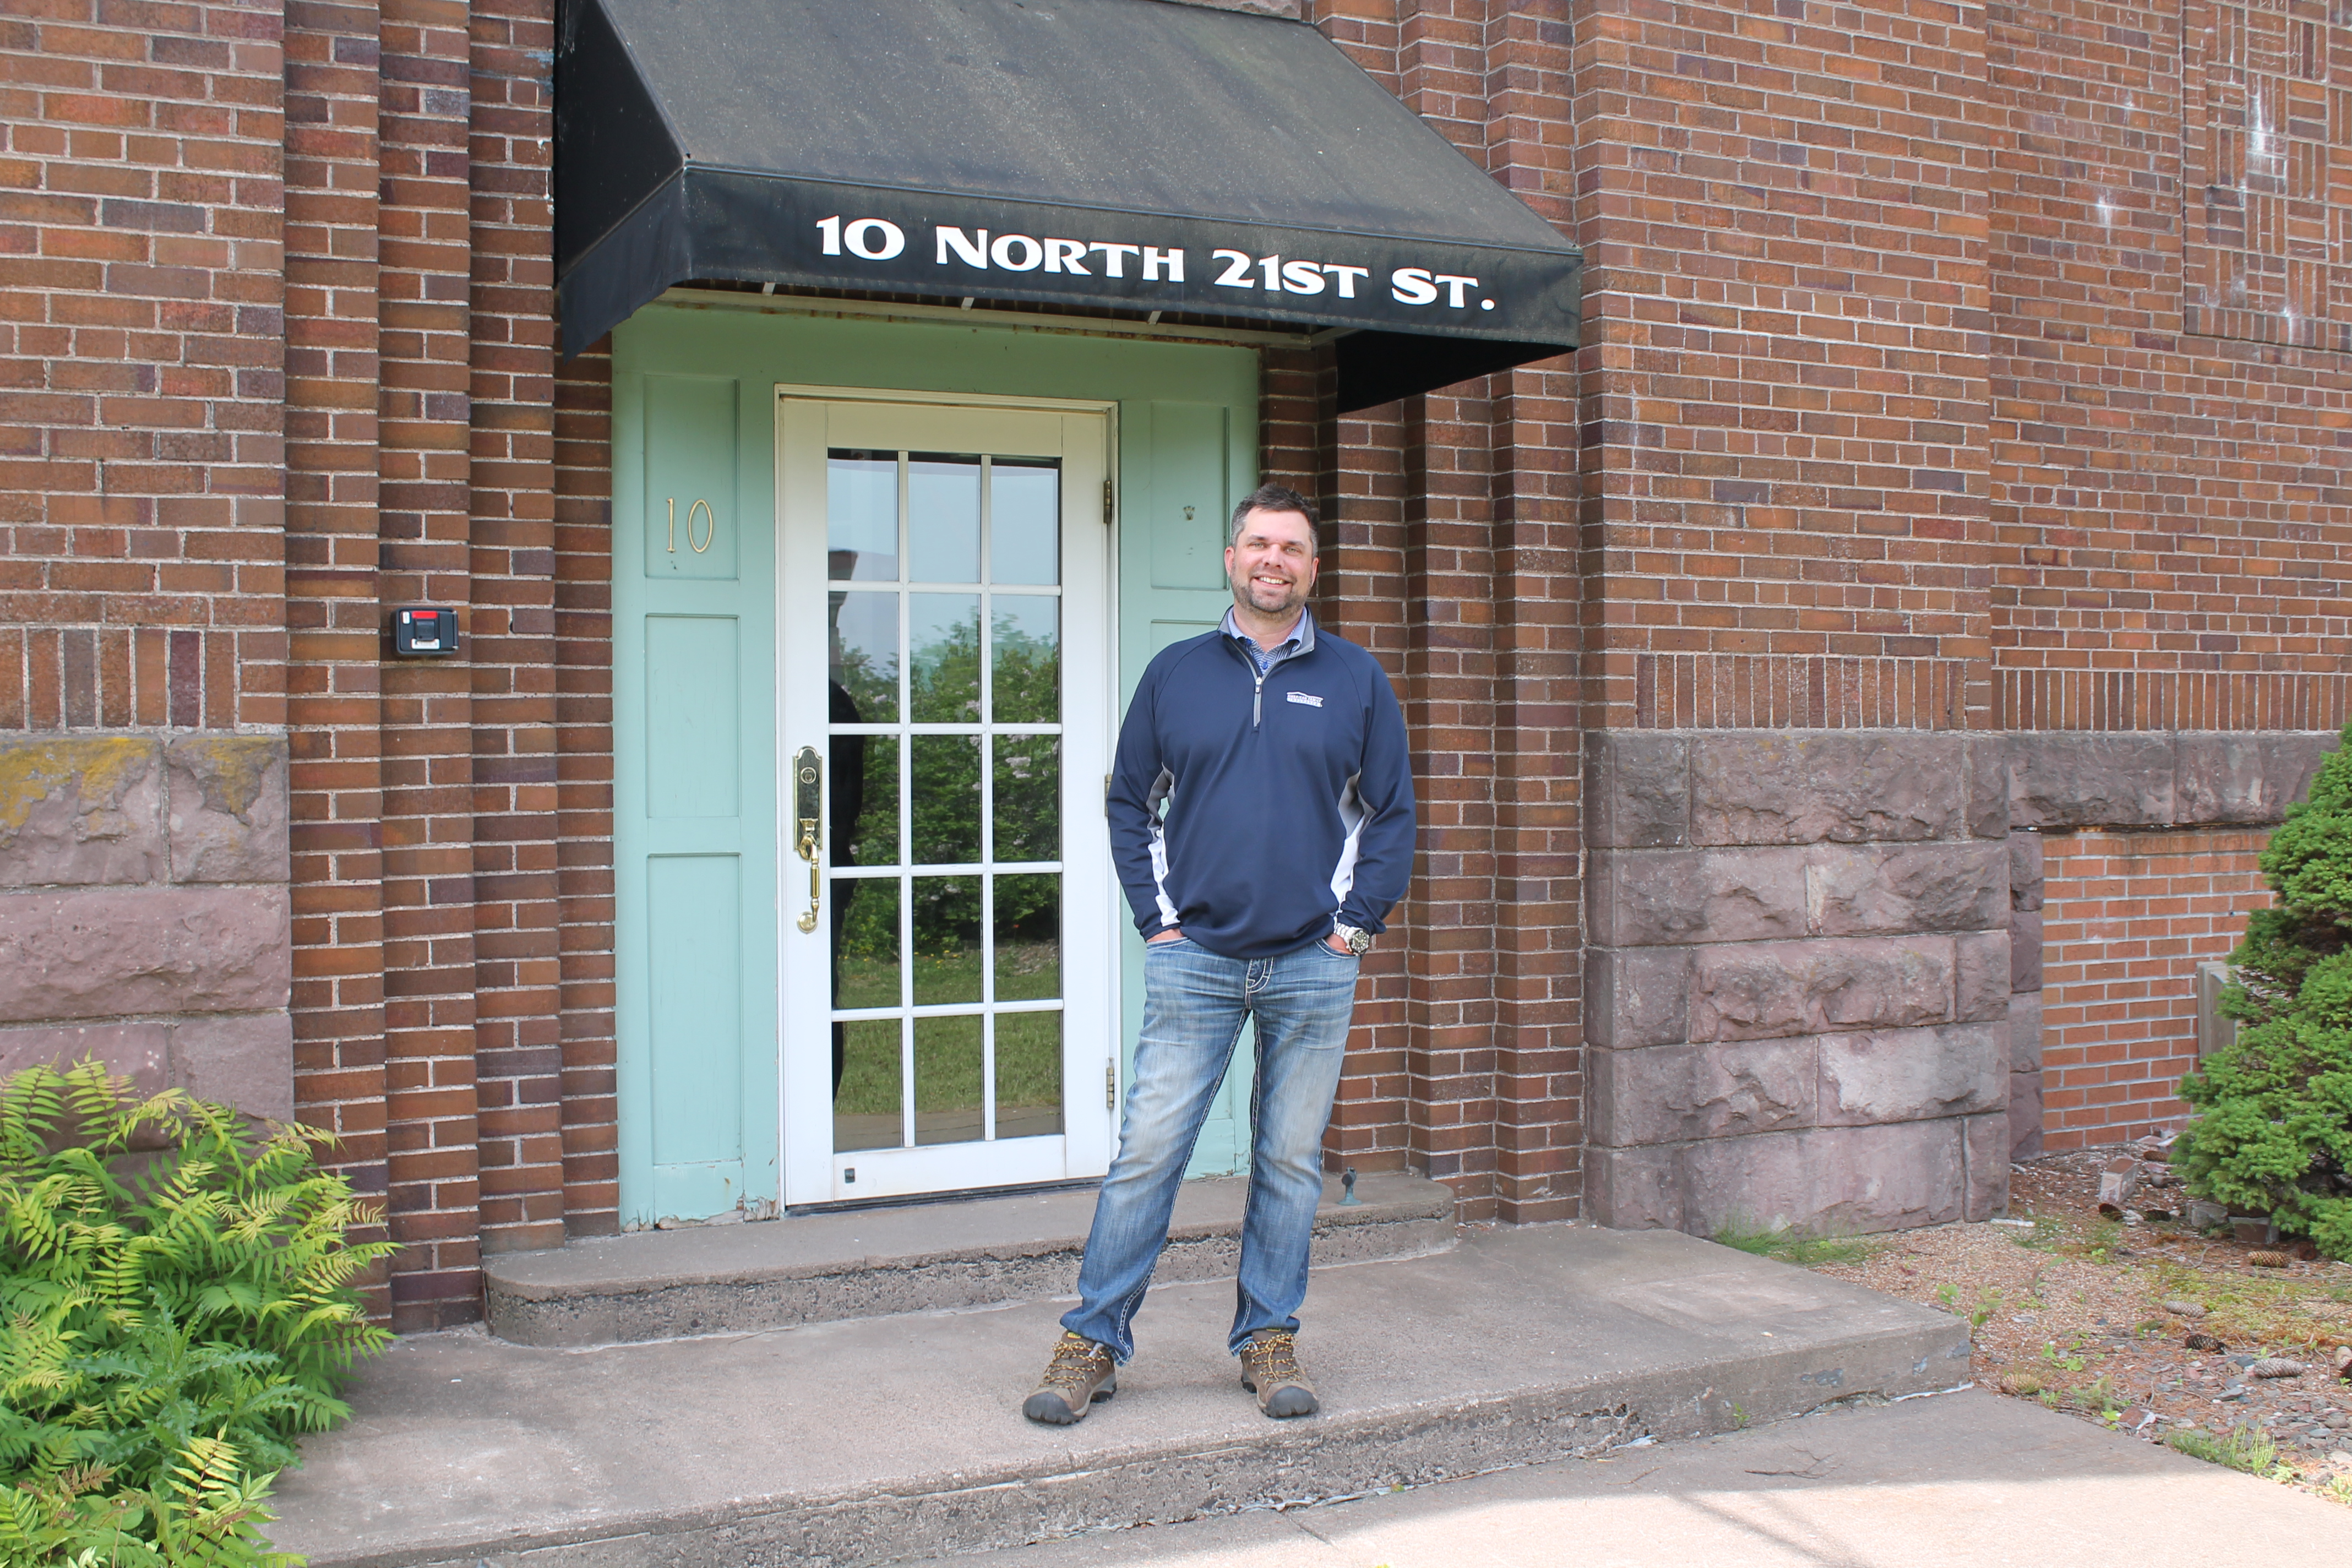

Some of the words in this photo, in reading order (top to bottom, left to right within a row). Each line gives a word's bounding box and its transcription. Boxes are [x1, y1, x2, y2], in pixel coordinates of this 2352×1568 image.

[816, 215, 905, 260] 10
[936, 226, 1184, 282] NORTH
[1212, 249, 1369, 298] 21ST
[1391, 268, 1495, 310] ST.
[666, 497, 714, 554] 10
